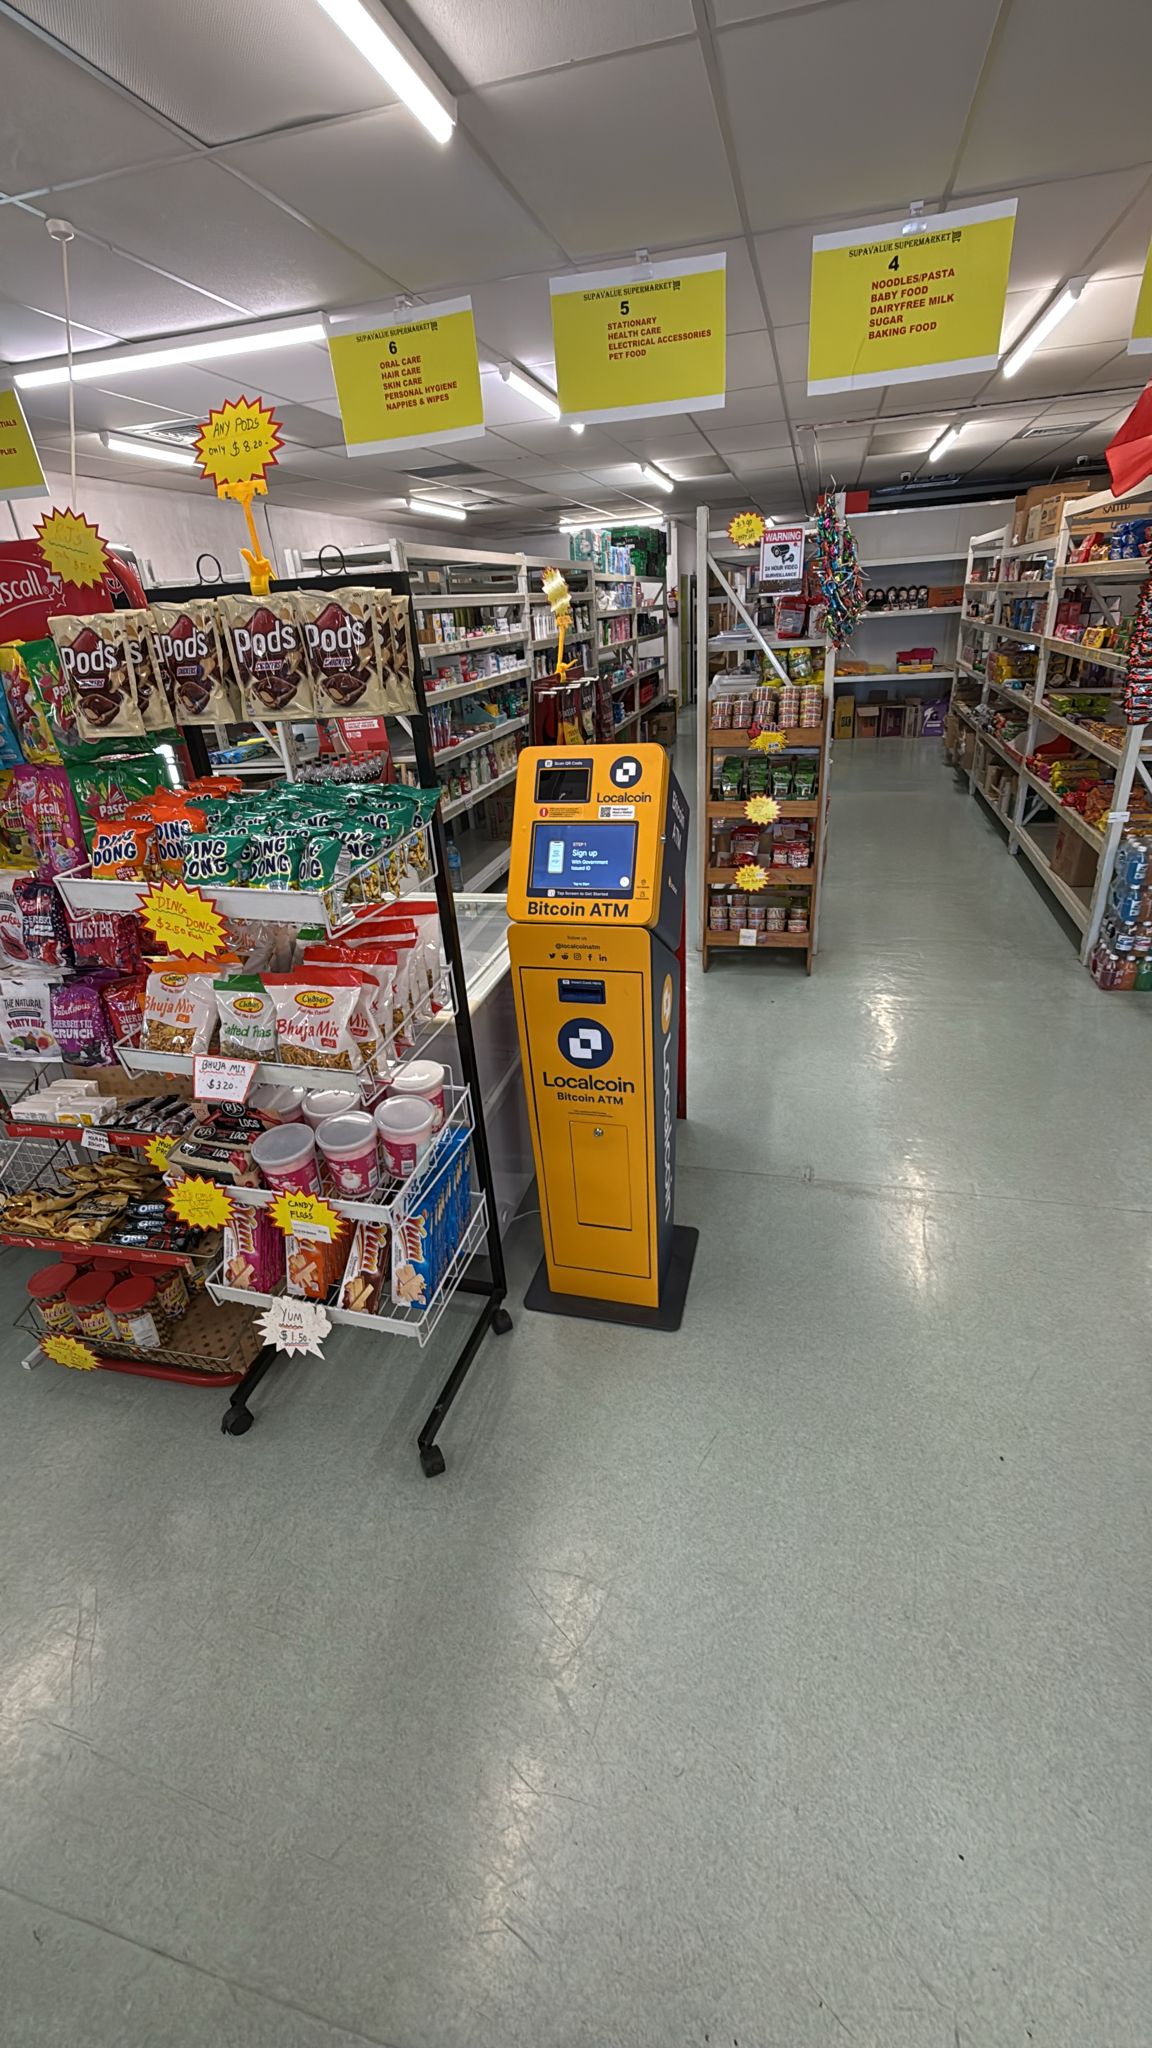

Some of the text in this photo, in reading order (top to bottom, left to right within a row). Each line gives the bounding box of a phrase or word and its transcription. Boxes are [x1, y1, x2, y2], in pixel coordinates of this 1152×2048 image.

[848, 232, 952, 258] SUPAVALUE SUPERMARKET
[888, 255, 899, 272] 4
[871, 268, 955, 290] NOODLES/PASTA
[583, 281, 673, 302] SUPAVALUE SUPERMARKET
[871, 285, 928, 303] BABY FOOD
[620, 301, 630, 315] 5
[870, 293, 955, 315] DAIRYFREE MILK
[607, 316, 657, 331] STATIONARY
[868, 321, 937, 340] BAKING FOOD
[869, 315, 904, 328] SUGAR
[356, 323, 431, 343] SUPAVALUE SUPERMARKET
[608, 326, 662, 341] HEALTH CARE
[608, 329, 712, 351] ELECTRICAL ACCESSORIES
[389, 341, 398, 355] 6
[609, 349, 647, 361] PET FOOD
[379, 355, 422, 370] ORAL CARE
[381, 366, 422, 380] HAIR CARE
[383, 377, 423, 391] SKIN CARE
[384, 380, 457, 401] PERSONAL HYGIENE
[386, 393, 450, 411] NAPPIES & WIPES
[213, 417, 260, 438] ANY PODS
[208, 445, 226, 456] only
[765, 531, 801, 542] WARNING
[161, 627, 208, 662] Pods
[233, 620, 296, 663] Pods
[305, 615, 366, 659] Pods
[60, 640, 118, 674] Pods
[596, 792, 652, 803] Localcoin
[98, 830, 136, 849] DING
[93, 843, 137, 867] DONG
[572, 849, 588, 858] Sign
[156, 896, 187, 914] DING
[527, 901, 629, 918] Bitcoin ATM
[186, 917, 216, 934] DONG
[15, 999, 43, 1010] NATURAL
[145, 996, 174, 1018] Bhuja
[175, 997, 195, 1014] Mix
[7, 1019, 30, 1030] PARTY
[53, 1028, 94, 1039] CRUNCH
[276, 1018, 340, 1042] Bhuja Mix
[201, 1059, 246, 1074] BHUJA MIX
[543, 1071, 635, 1093] Localcoin
[557, 1092, 624, 1105] Bitcoin ATM
[663, 1031, 672, 1223] Localcoin
[138, 1204, 165, 1214] OREO
[288, 1200, 314, 1211] CANDY
[121, 1234, 149, 1243] OREO
[400, 1215, 428, 1263] Yum
[360, 1223, 387, 1274] Yum
[280, 1306, 303, 1324] YUM
